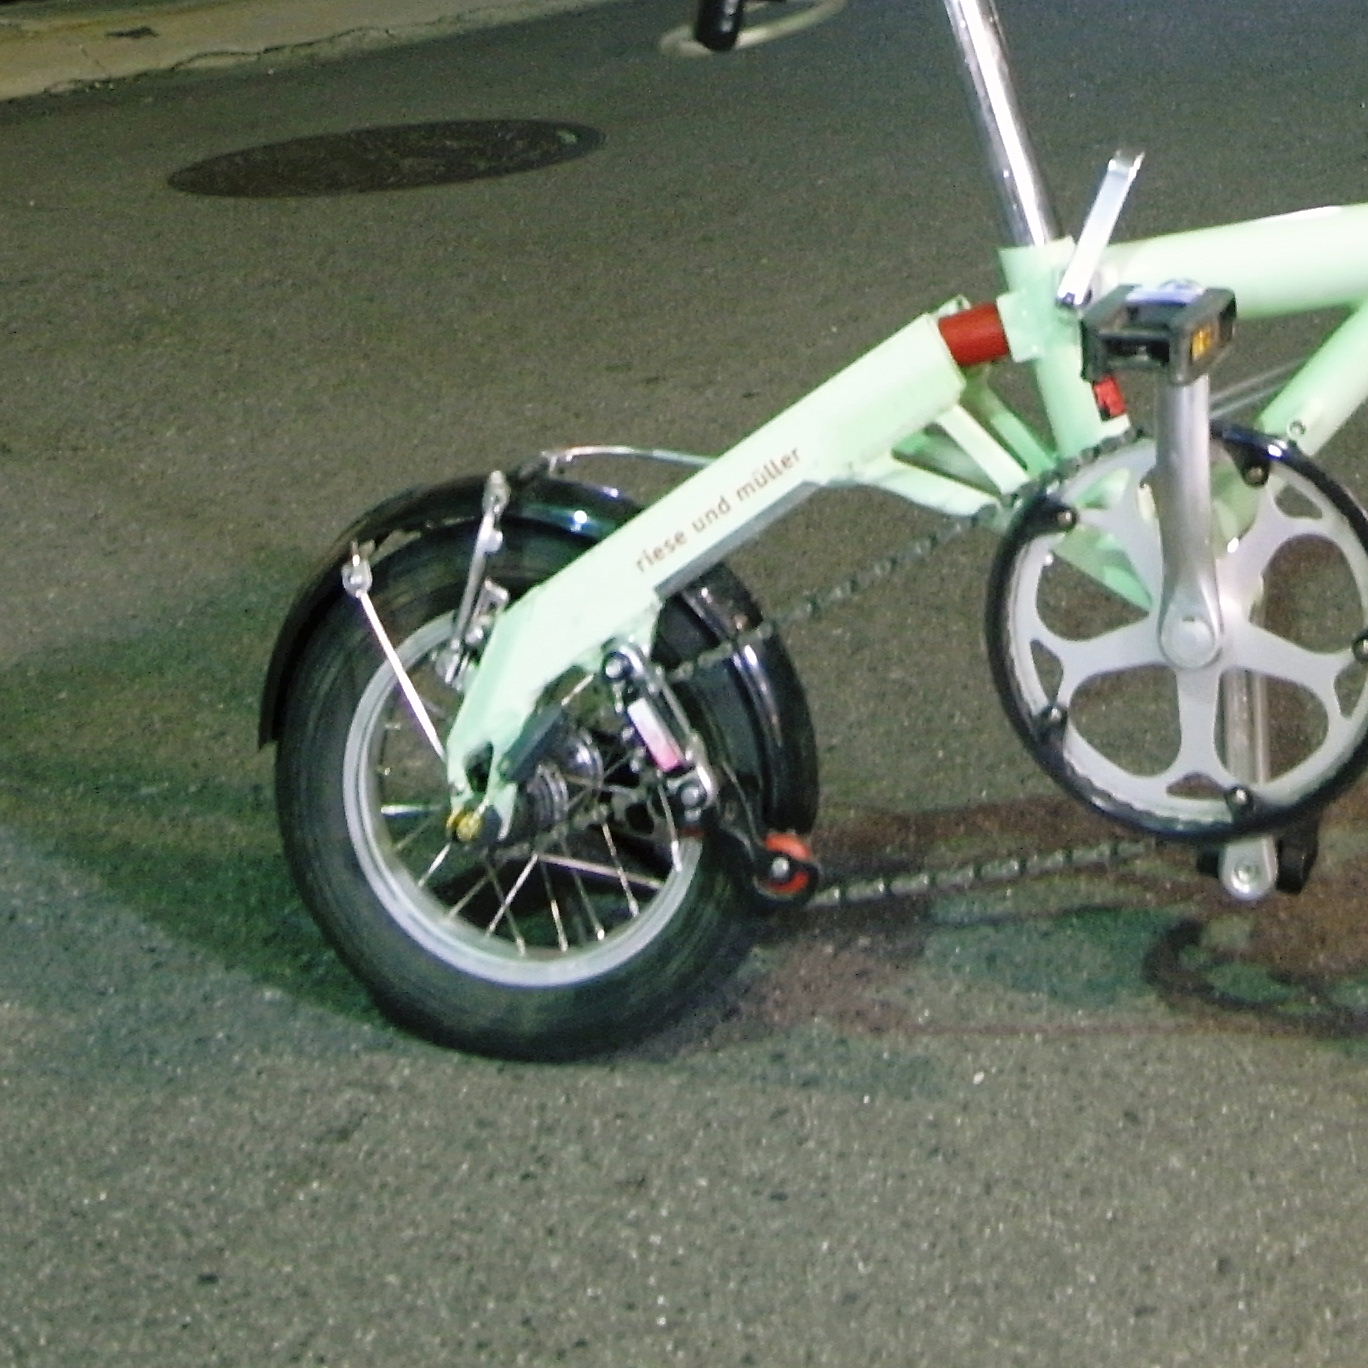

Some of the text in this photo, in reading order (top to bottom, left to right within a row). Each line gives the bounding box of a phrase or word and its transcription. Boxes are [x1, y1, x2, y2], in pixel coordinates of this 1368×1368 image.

[636, 447, 801, 572] riese und müller
